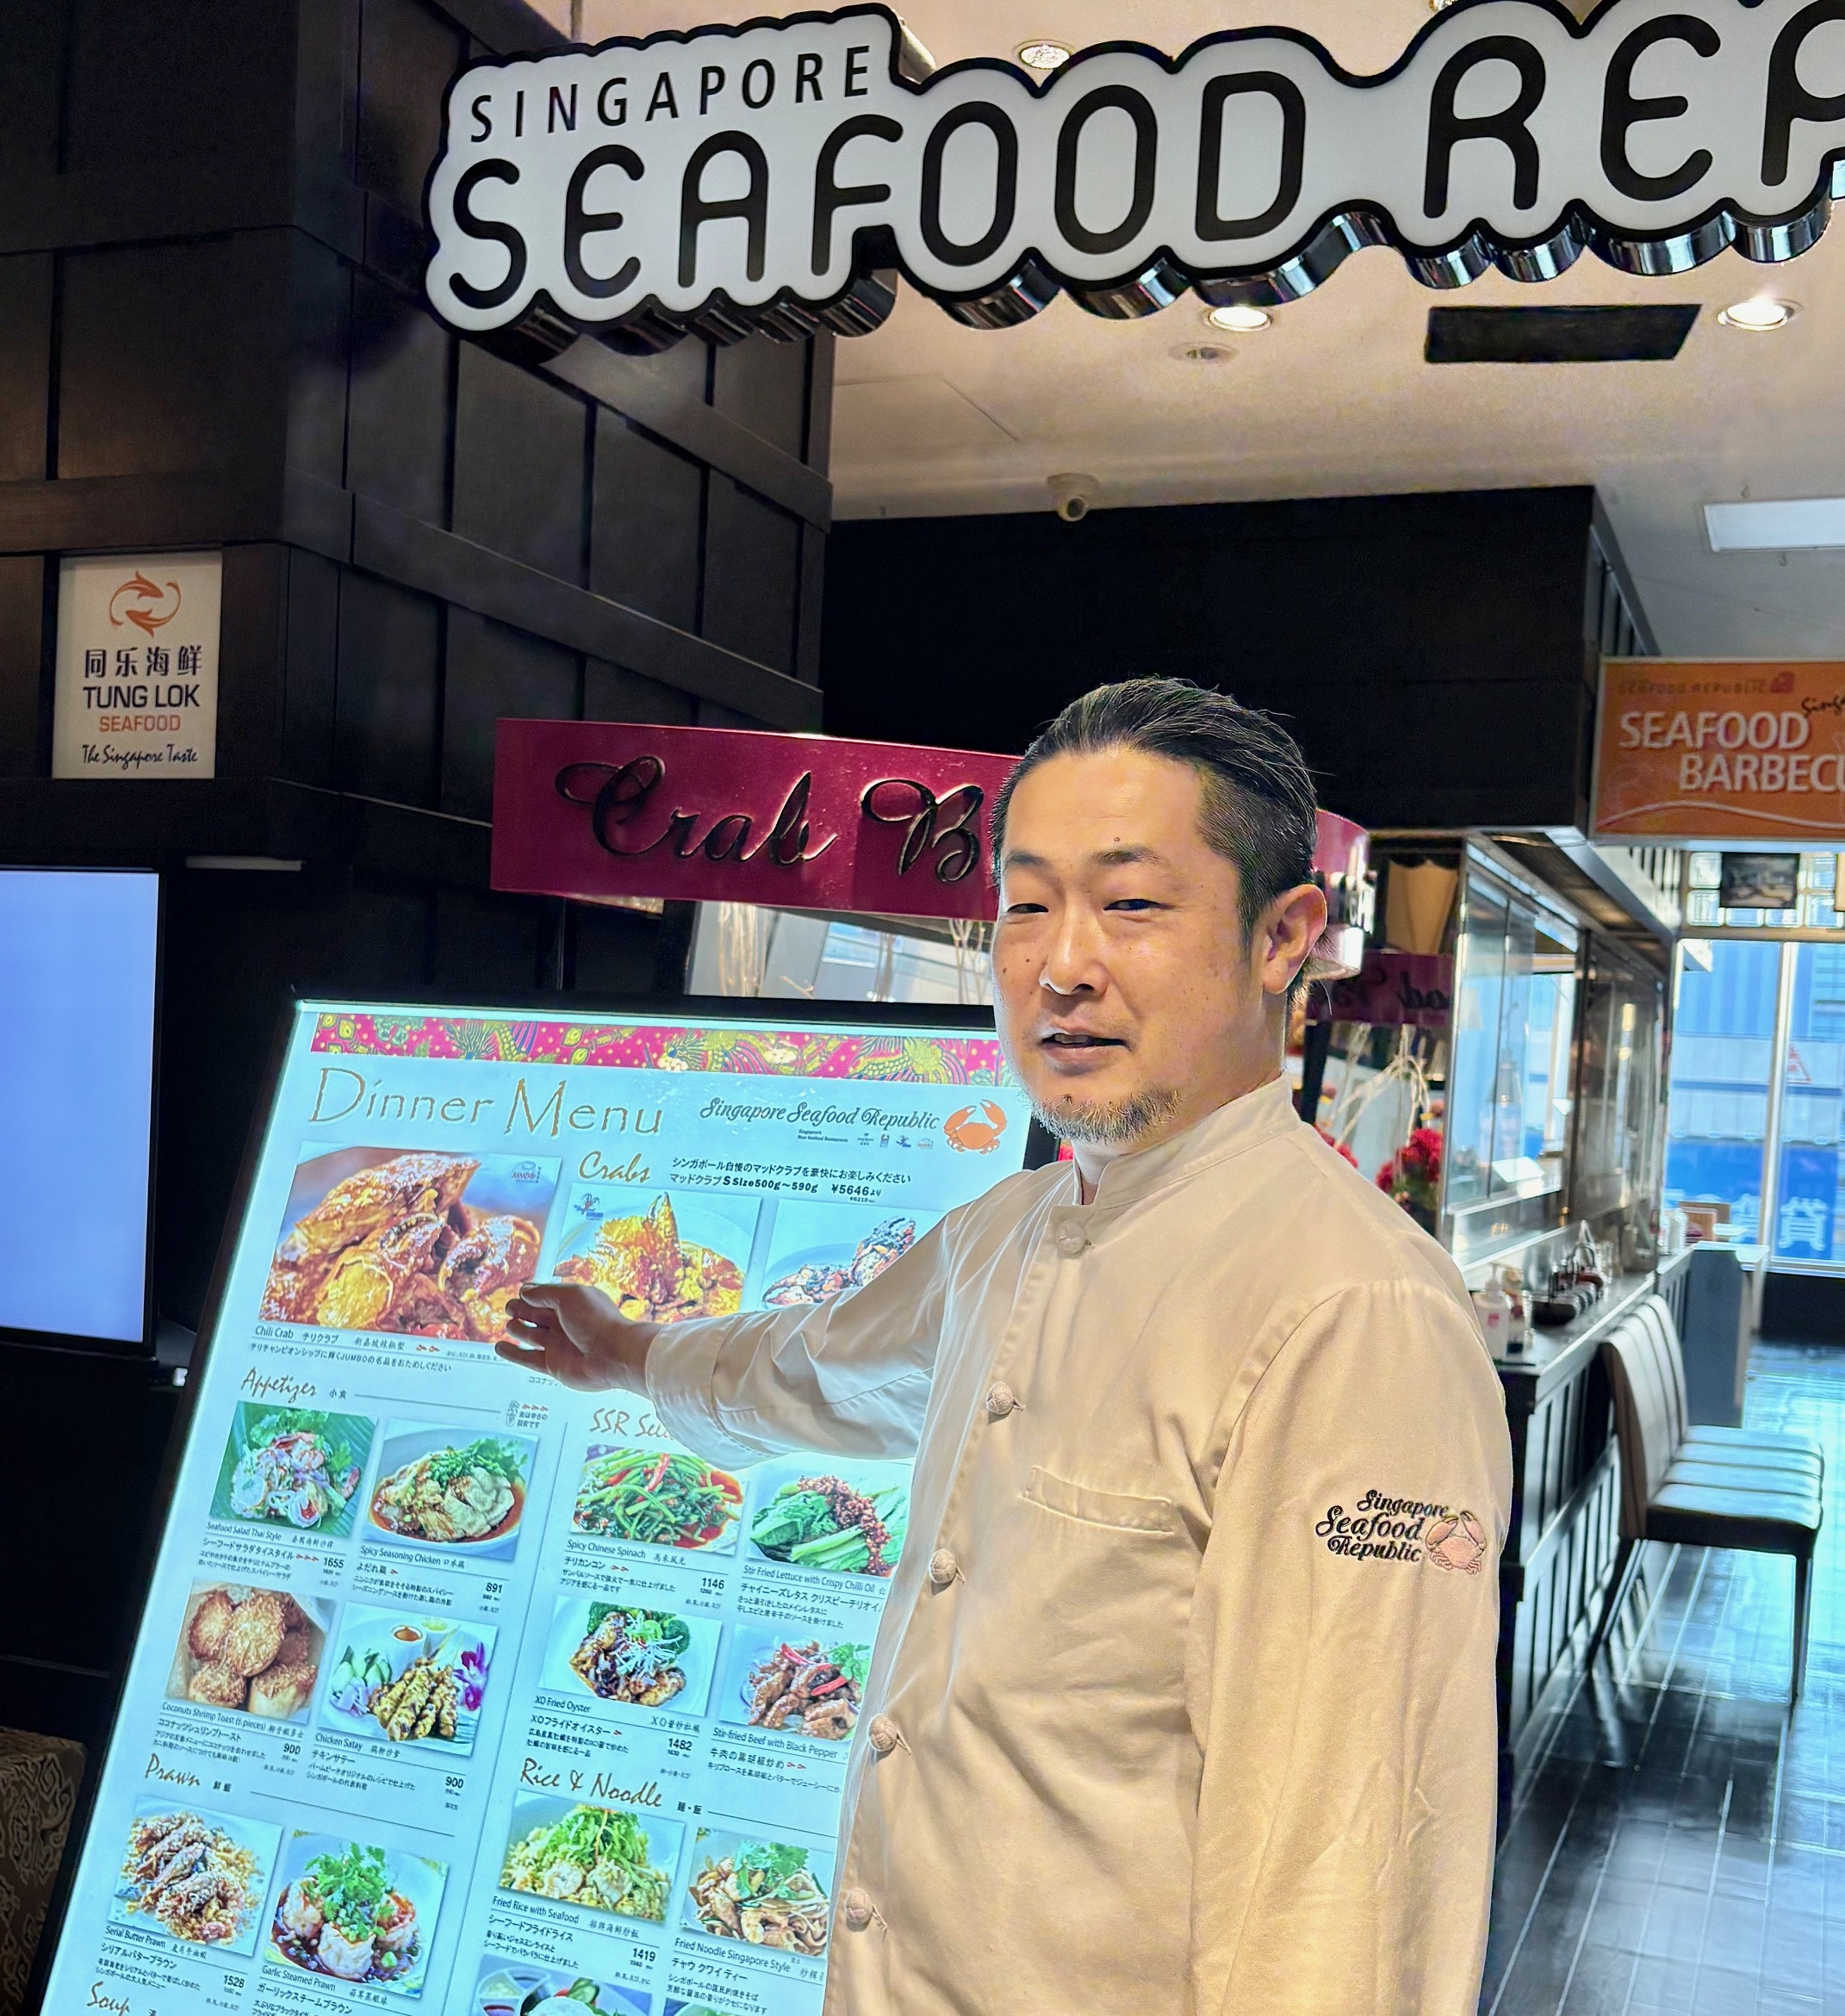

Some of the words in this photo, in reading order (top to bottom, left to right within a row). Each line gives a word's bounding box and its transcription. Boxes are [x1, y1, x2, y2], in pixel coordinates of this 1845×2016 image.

[470, 46, 871, 143] SINGAPORE
[449, 71, 1306, 308] SEAFOOD
[84, 645, 202, 678] 同乐海鲜
[83, 685, 147, 709] TUNG
[155, 685, 200, 707] LOK
[99, 715, 181, 732] SEAFOOD
[1619, 710, 1811, 750] SEAFOOD
[83, 744, 100, 763] The
[102, 744, 163, 770] Singapore
[167, 743, 198, 764] Taste
[554, 755, 837, 866] Crab
[308, 1067, 494, 1124] Dinner
[504, 1078, 663, 1138] Menu
[699, 1097, 786, 1123] Singapore
[787, 1101, 859, 1128] Seafood
[860, 1107, 940, 1131] Republic
[579, 1150, 651, 1184] Crabs
[255, 1326, 273, 1337] Chili
[274, 1328, 294, 1339] Crab
[302, 1332, 339, 1344] チリクラブ
[241, 1367, 316, 1404] Appetizer
[590, 1408, 630, 1436] SSR
[1357, 1489, 1449, 1518] Singapore
[207, 1522, 233, 1534] Seafood
[233, 1526, 250, 1535] Salad
[252, 1528, 264, 1537] Thai
[265, 1530, 283, 1541] Style
[1315, 1504, 1426, 1541] Seafood
[360, 1545, 379, 1556] Spicy
[380, 1548, 413, 1562] Seasoning
[414, 1553, 441, 1566] Chicken
[567, 1539, 587, 1551] Spicy
[588, 1542, 616, 1554] Chinese
[617, 1547, 646, 1559] Spinach
[1327, 1535, 1422, 1562] Republic
[323, 1557, 344, 1569] 1655
[486, 1582, 503, 1593] 891
[702, 1578, 725, 1590] 1146
[743, 1565, 756, 1574] Stir
[757, 1567, 775, 1578] Fried
[776, 1570, 804, 1582] Lettuce
[804, 1574, 820, 1585] with
[822, 1577, 844, 1590] Crispy
[865, 1583, 876, 1593] Oil
[162, 1701, 192, 1716] Coconuts
[192, 1707, 216, 1721] Shrimp
[217, 1713, 234, 1724] Toast
[242, 1717, 266, 1732] pieces)
[535, 1696, 546, 1704] XO
[547, 1697, 566, 1709] Fried
[567, 1701, 591, 1713] Oyster
[283, 1742, 301, 1756] 900
[315, 1734, 343, 1747] Chicken
[344, 1738, 363, 1752] Satay
[668, 1738, 693, 1751] 1482
[712, 1727, 747, 1741] Stir-fried
[748, 1734, 767, 1745] Beef
[767, 1738, 785, 1749] with
[786, 1740, 806, 1753] Black
[809, 1744, 838, 1759] Pepper
[145, 1752, 202, 1787] Prawn
[445, 1776, 464, 1789] 900
[520, 1757, 560, 1787] Rice
[570, 1769, 584, 1791] &
[590, 1772, 662, 1808] Noodle
[492, 1895, 512, 1908] Fried
[512, 1901, 527, 1912] Rice
[529, 1904, 547, 1916] with
[548, 1909, 580, 1923] Seafood
[105, 1926, 124, 1938] Serial
[125, 1931, 145, 1943] Butter
[146, 1936, 166, 1948] Prawn
[633, 1947, 656, 1962] 1419
[674, 1938, 695, 1951] Fried
[697, 1943, 727, 1957] Noodle
[728, 1950, 769, 1967] Singapore
[770, 1959, 792, 1973] Style
[223, 1975, 245, 1988] 1528
[262, 1964, 282, 1978] Garlic
[283, 1970, 313, 1985] Steamed
[314, 1978, 336, 1992] Prawn
[86, 1981, 130, 2016] Soup
